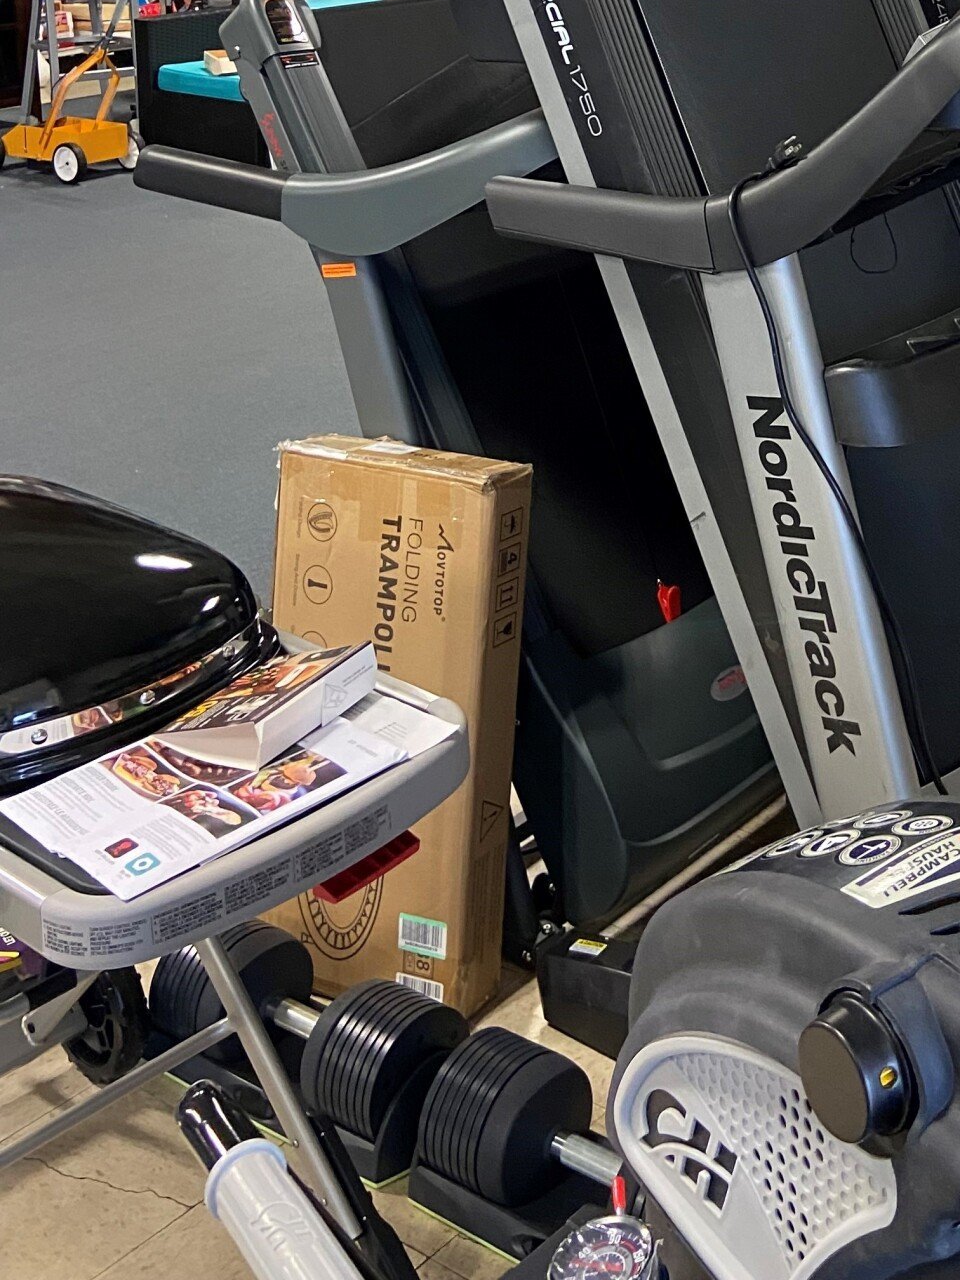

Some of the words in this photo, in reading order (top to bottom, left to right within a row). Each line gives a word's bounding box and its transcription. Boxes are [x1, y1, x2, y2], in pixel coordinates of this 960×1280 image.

[569, 65, 603, 137] 1750
[401, 517, 424, 623] FOLDING
[746, 395, 862, 757] NordicTrack
